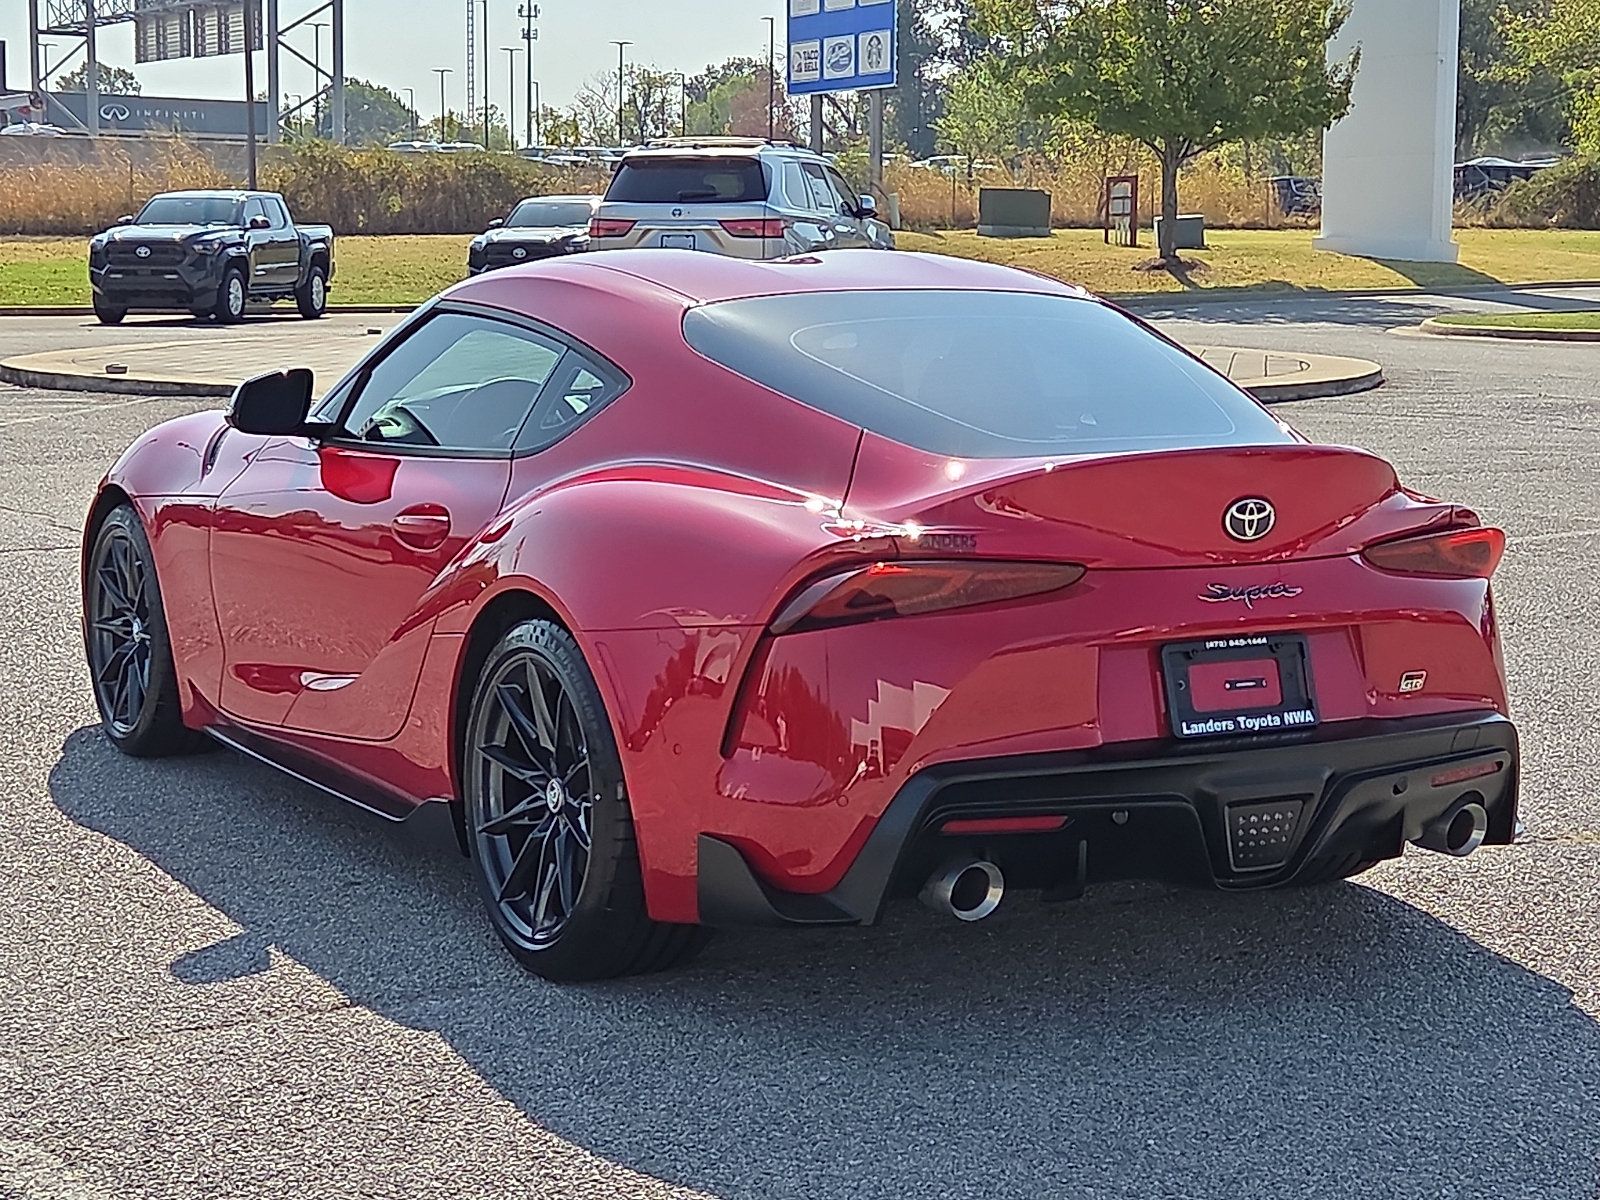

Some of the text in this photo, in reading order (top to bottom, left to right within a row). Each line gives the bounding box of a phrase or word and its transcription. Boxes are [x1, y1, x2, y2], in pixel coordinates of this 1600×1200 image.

[136, 109, 205, 119] INFINITI
[1198, 582, 1303, 609] Supra
[1182, 710, 1315, 735] Landers Toyota NWA
